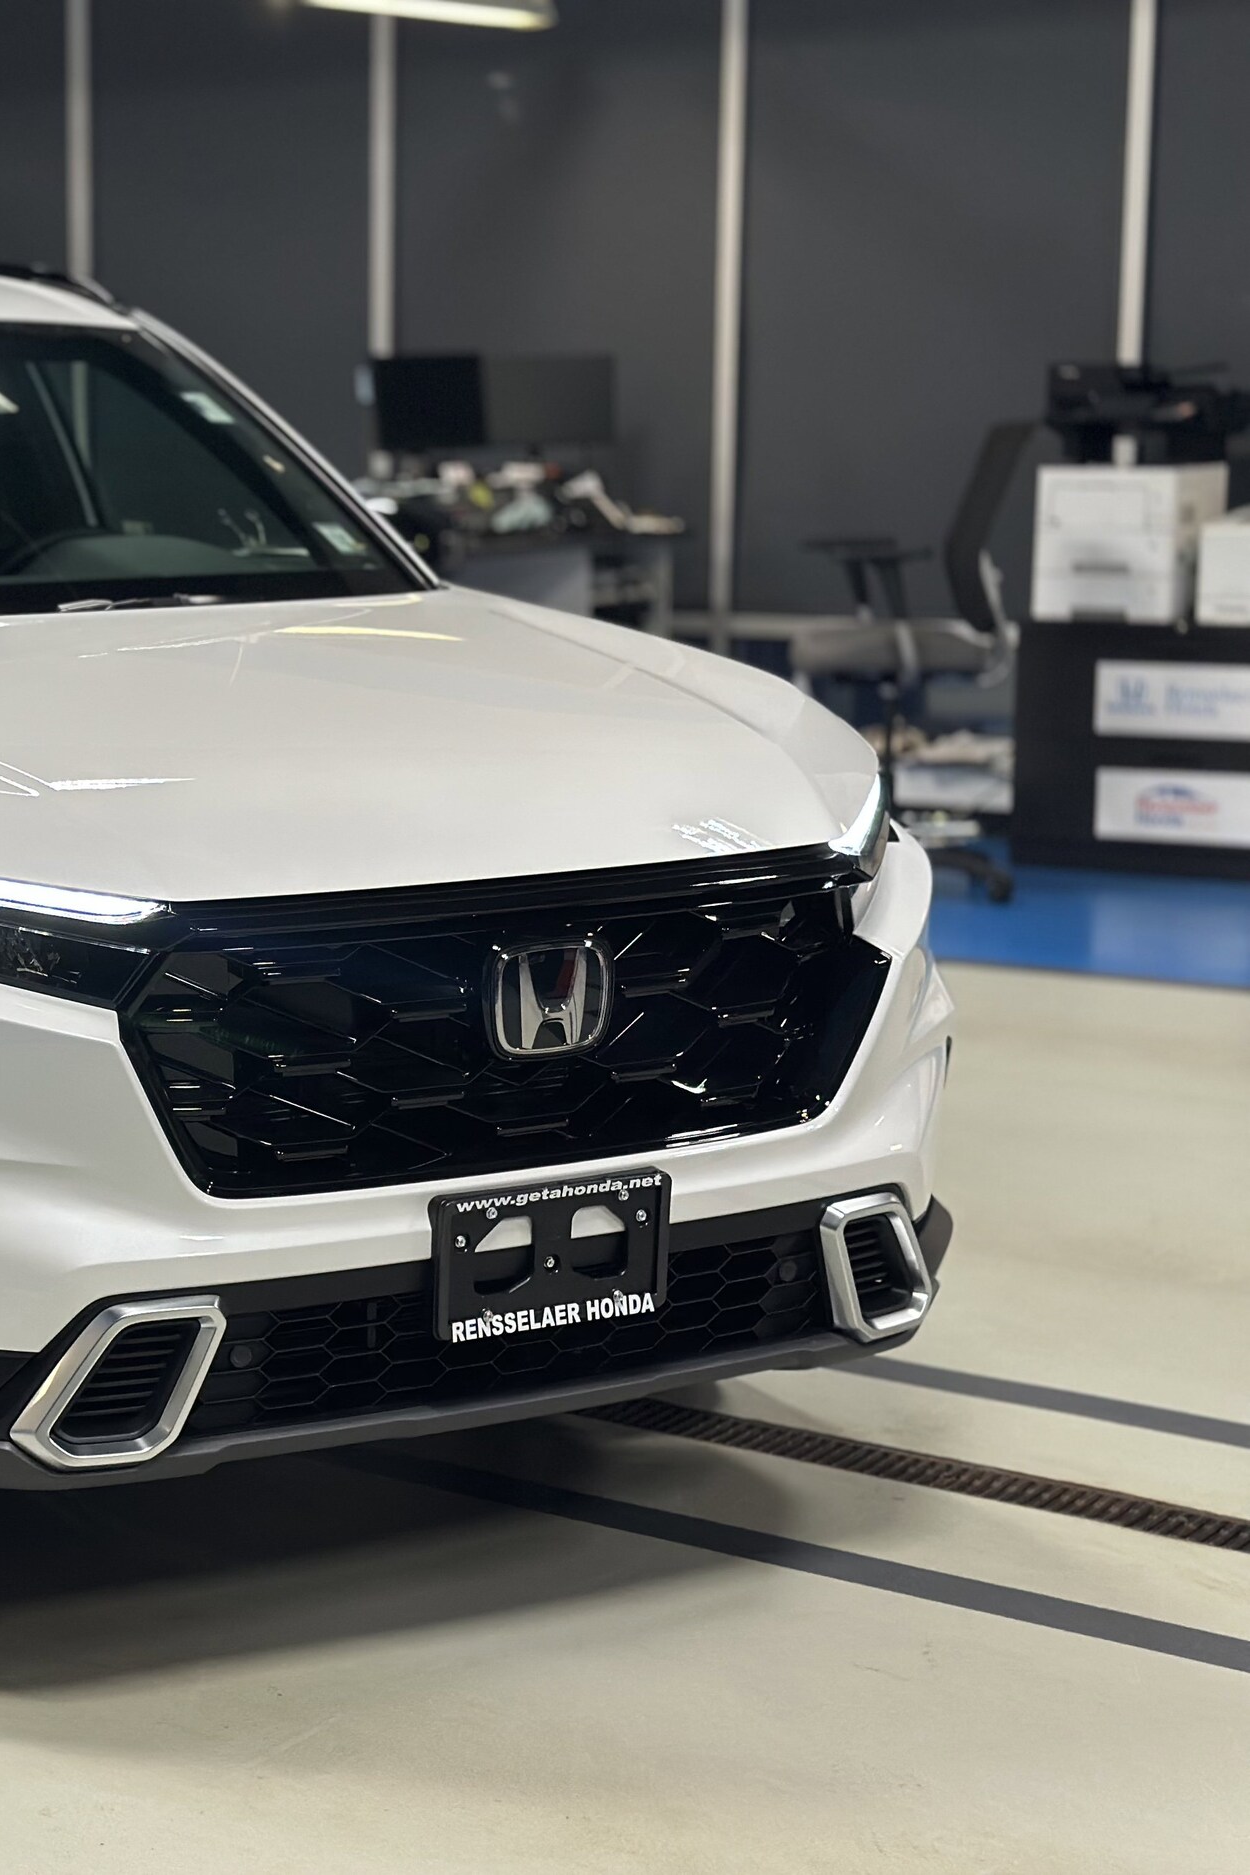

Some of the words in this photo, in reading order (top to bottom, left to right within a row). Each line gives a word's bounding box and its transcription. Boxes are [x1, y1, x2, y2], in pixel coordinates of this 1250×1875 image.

[456, 1173, 662, 1213] www.getahonda.net
[452, 1303, 581, 1343] RENSSELAER
[586, 1292, 655, 1321] HONDA
